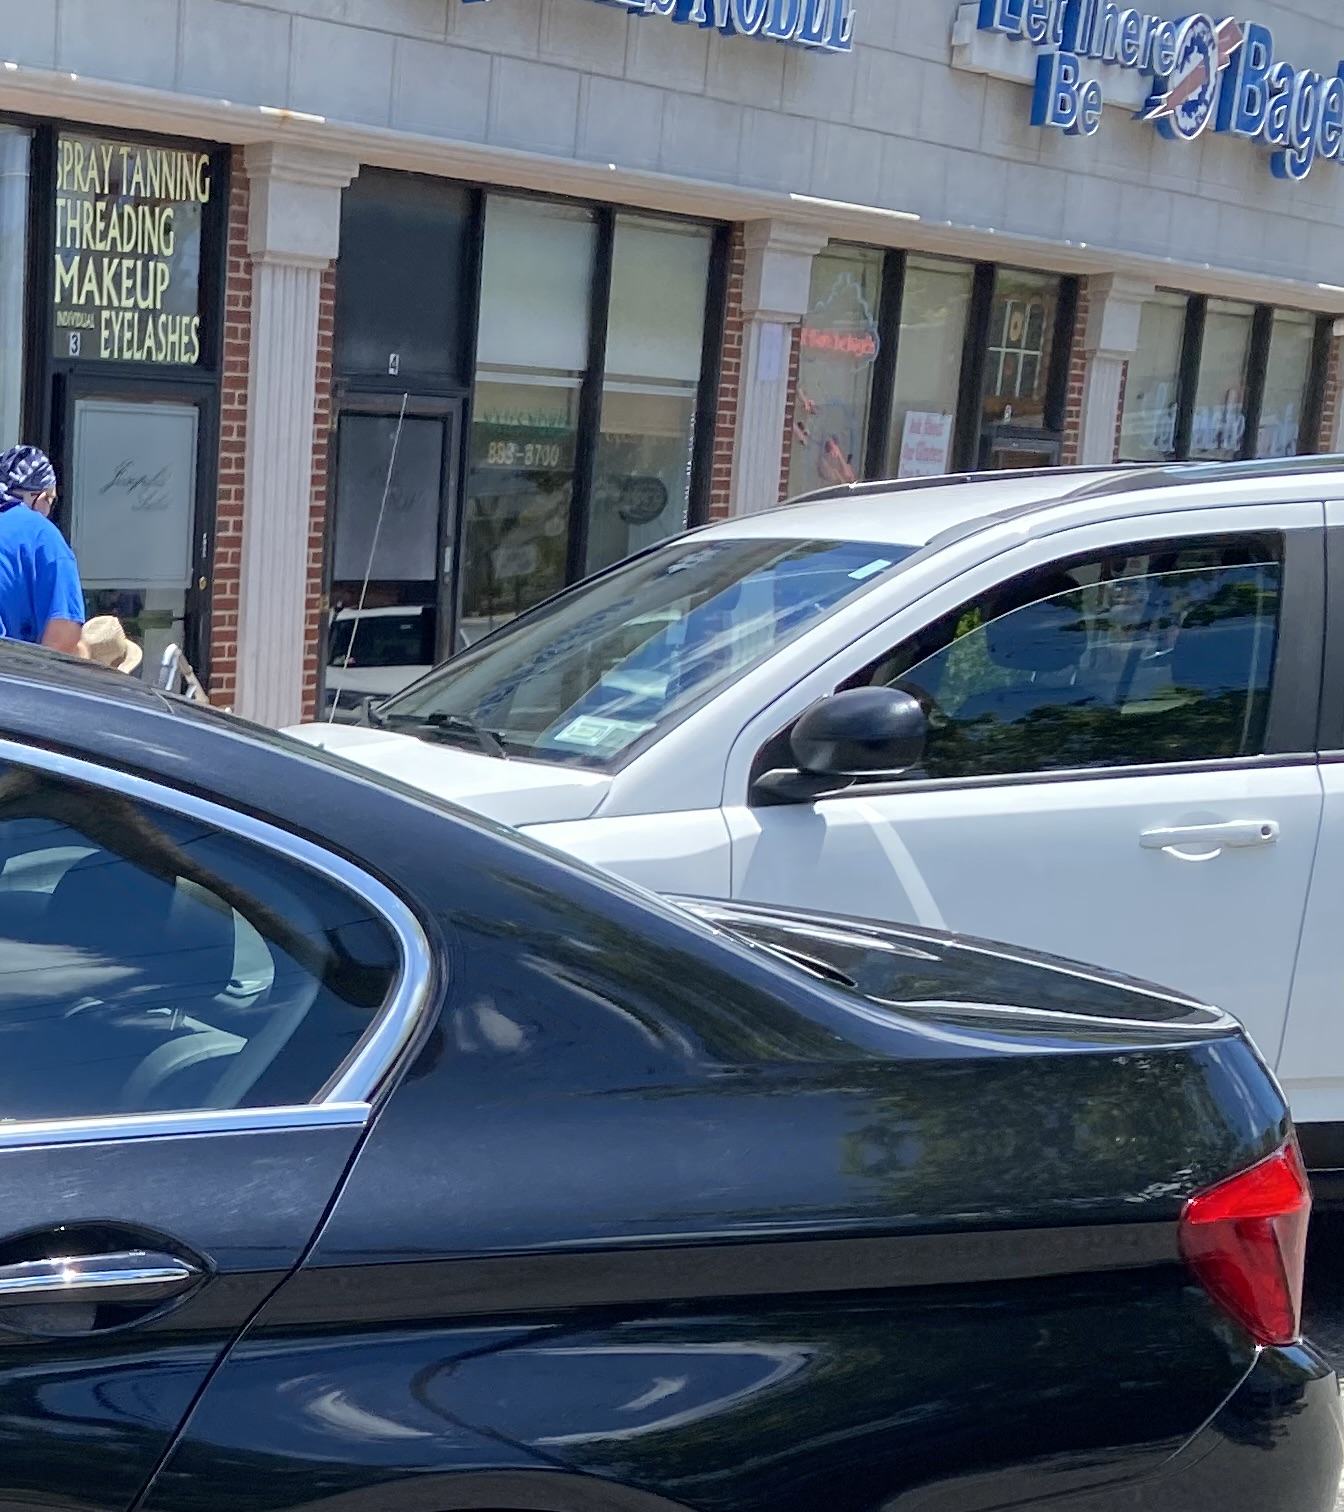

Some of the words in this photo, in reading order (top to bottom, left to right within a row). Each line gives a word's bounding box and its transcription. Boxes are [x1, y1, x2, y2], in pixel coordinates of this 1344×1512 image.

[1045, 51, 1102, 136] Be
[1227, 20, 1344, 181] Bage
[119, 146, 210, 203] TANNING
[56, 198, 174, 256] THREADING
[54, 254, 170, 310] MAKEUP
[70, 333, 79, 354] 3
[100, 310, 200, 365] EYELASHES
